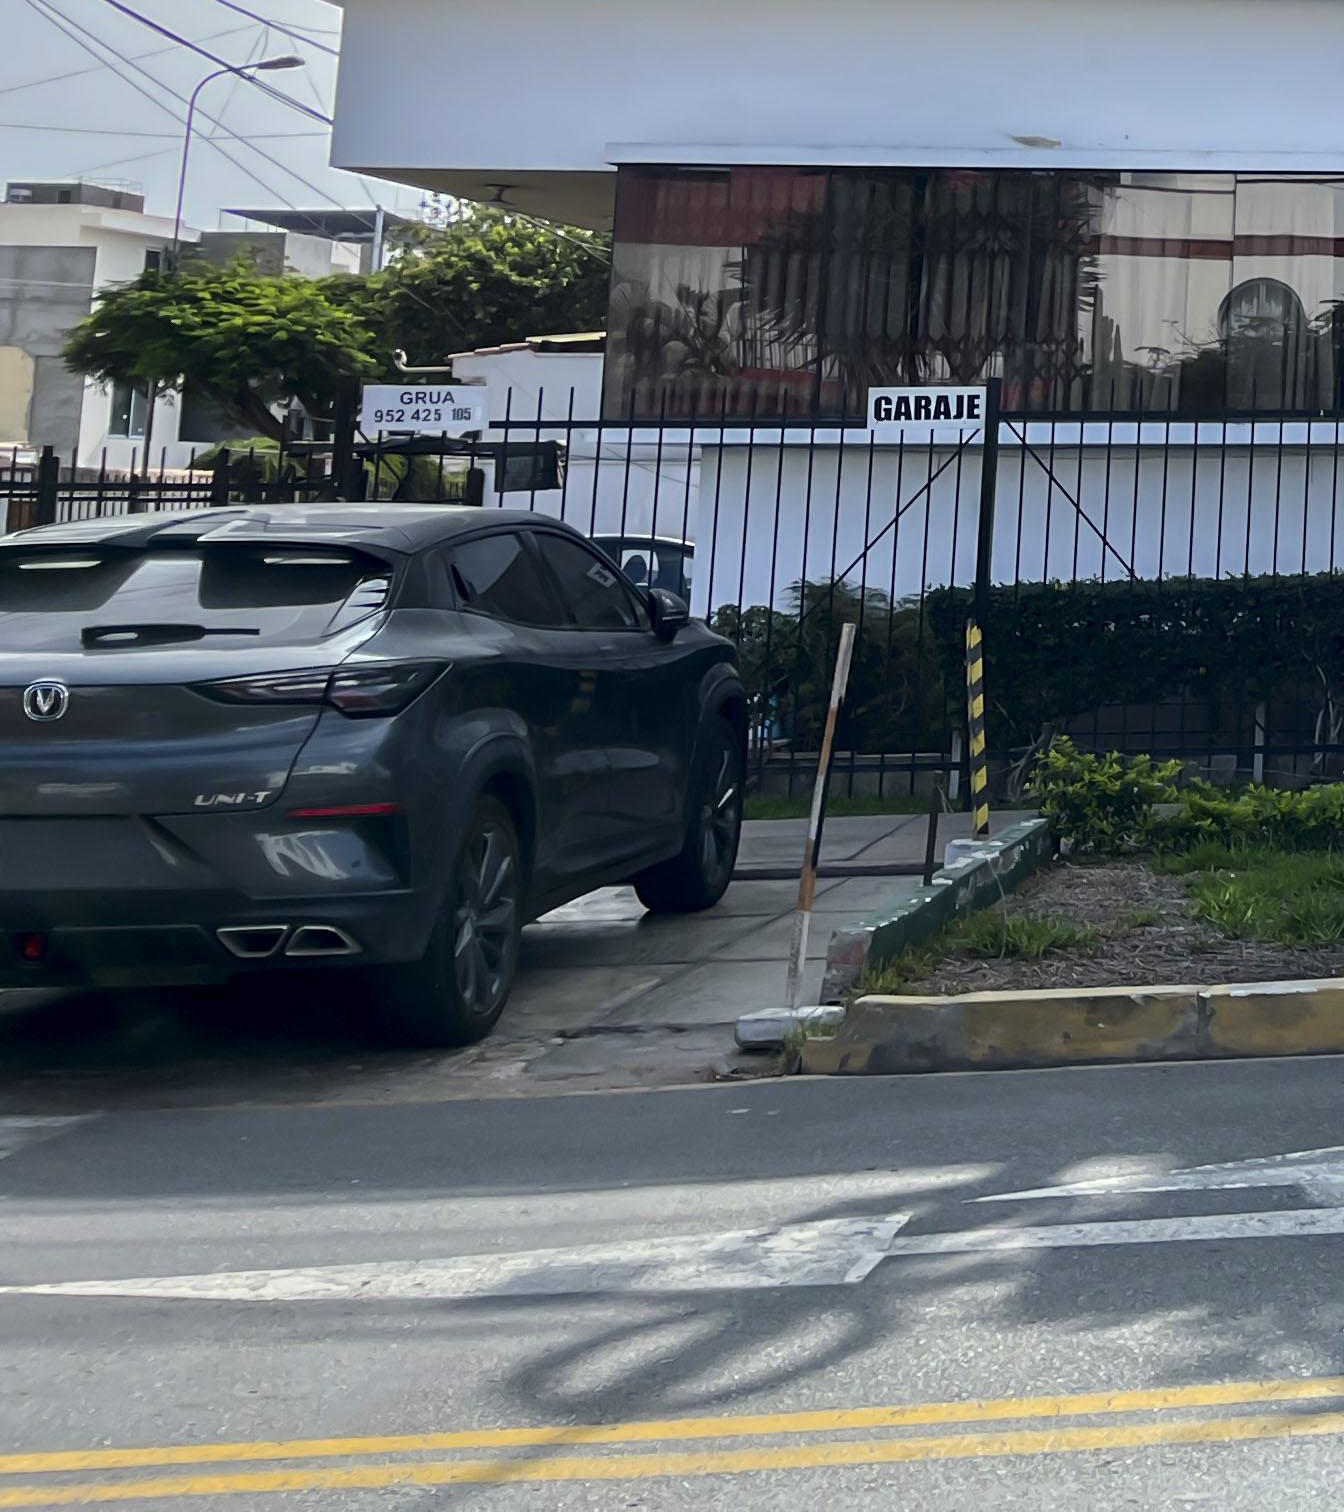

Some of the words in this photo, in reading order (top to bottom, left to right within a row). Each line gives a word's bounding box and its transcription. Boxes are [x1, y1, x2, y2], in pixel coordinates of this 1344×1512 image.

[400, 391, 455, 405] GRUA
[374, 409, 405, 423] 952
[410, 408, 441, 422] 425
[452, 407, 471, 421] 105
[874, 394, 981, 422] GARAJE
[194, 791, 272, 806] UNI-T
